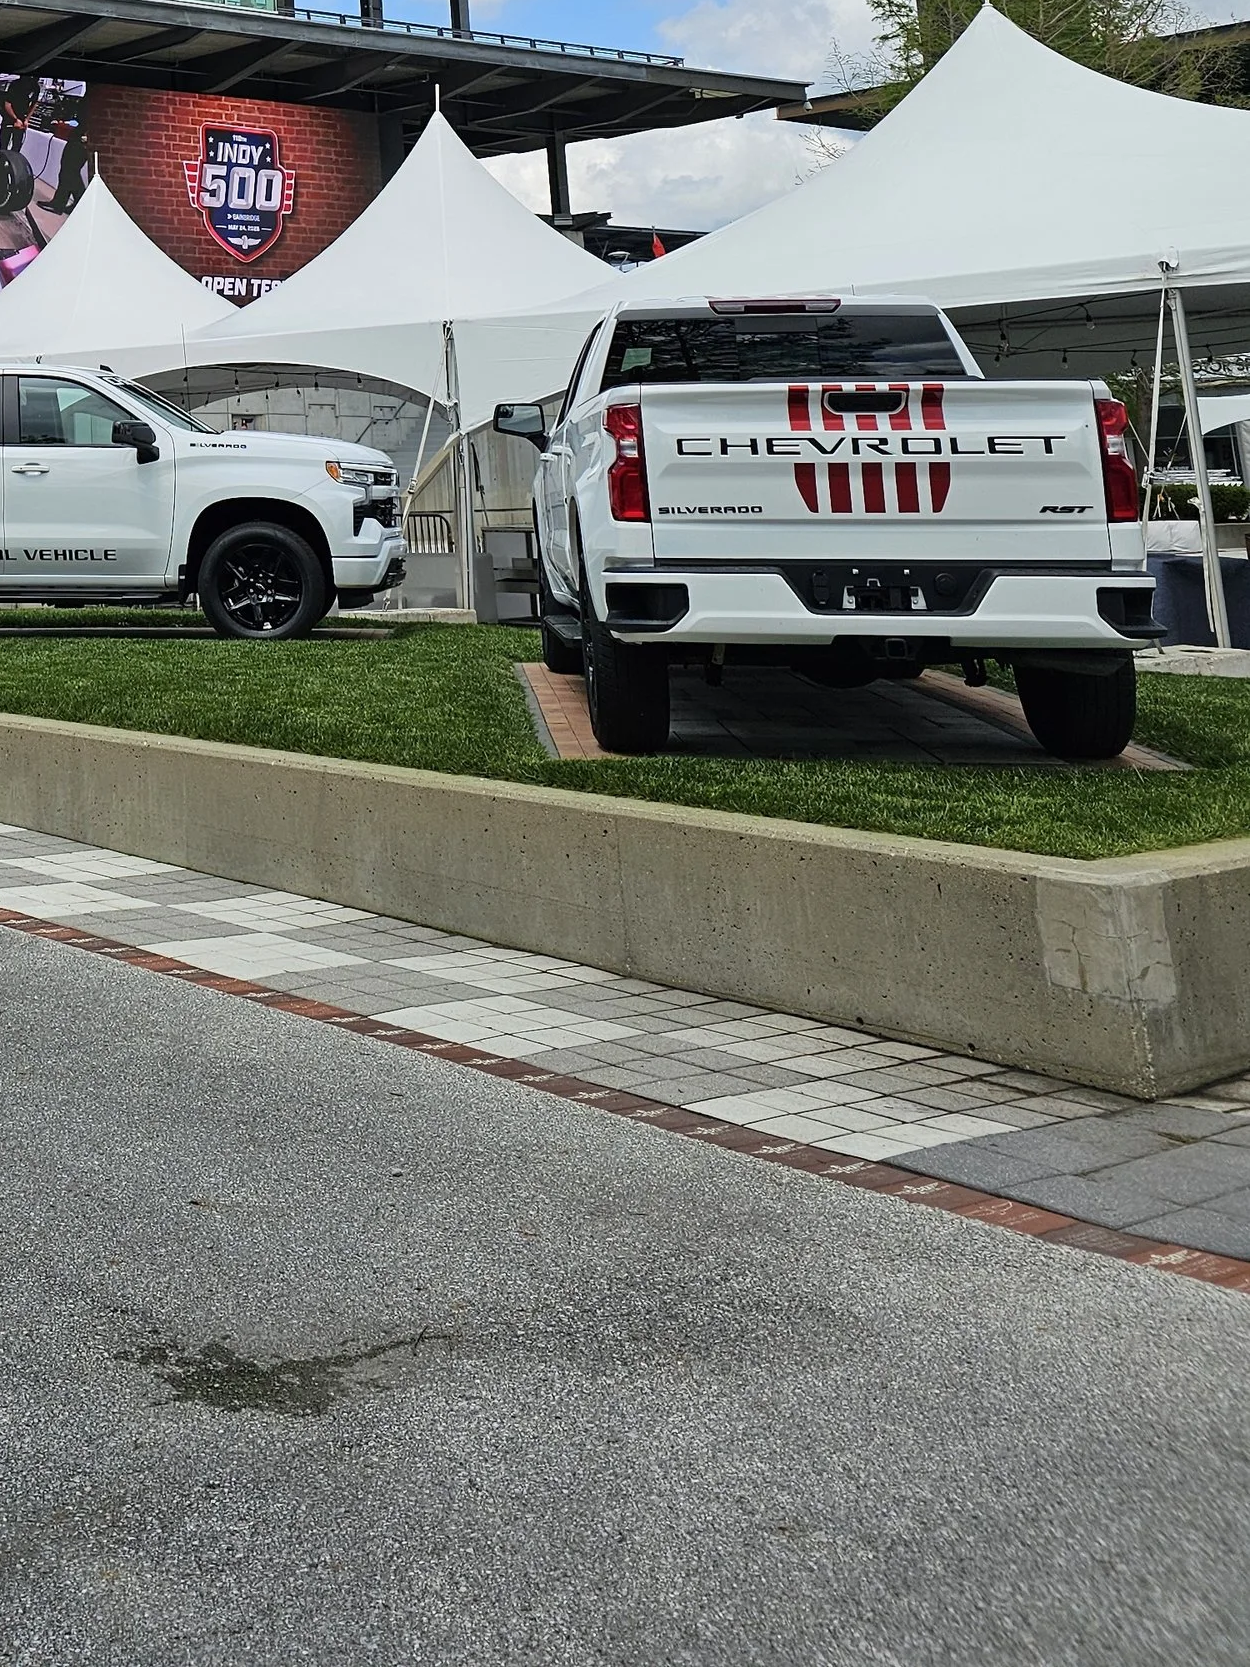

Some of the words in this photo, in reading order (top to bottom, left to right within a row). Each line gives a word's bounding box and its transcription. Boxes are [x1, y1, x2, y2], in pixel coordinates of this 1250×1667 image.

[216, 141, 264, 165] INDY
[199, 163, 283, 212] 500
[676, 436, 1066, 456] CHEVROLET
[658, 505, 763, 515] SILVERADO
[1039, 505, 1094, 514] RST
[23, 549, 117, 561] VEHICLE
